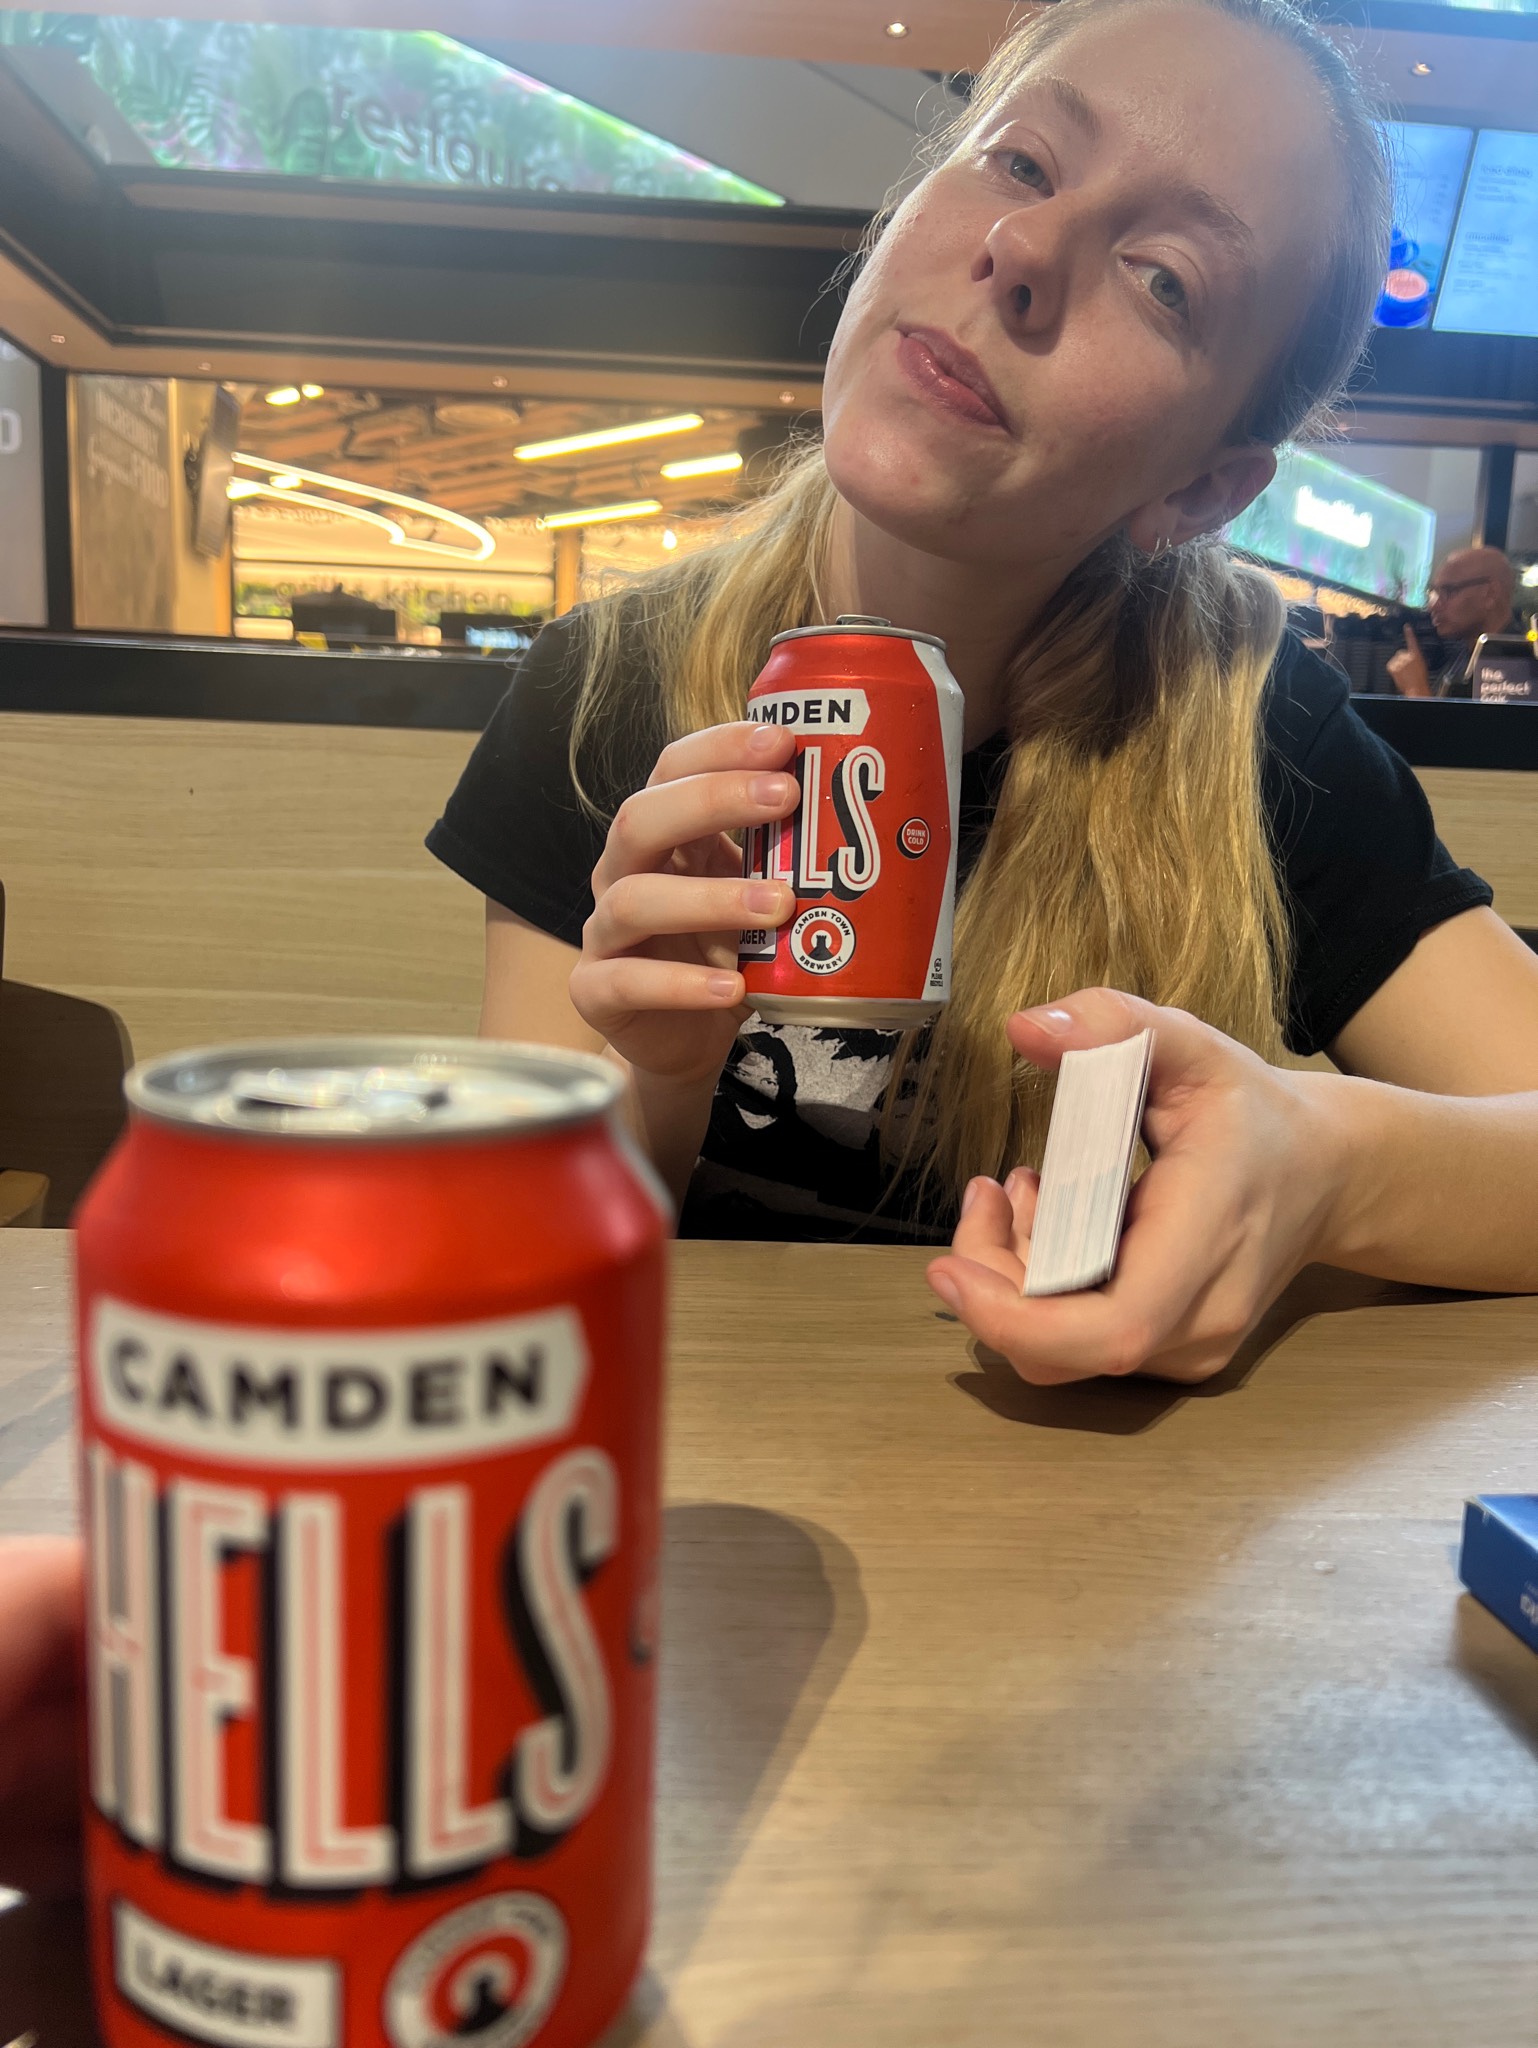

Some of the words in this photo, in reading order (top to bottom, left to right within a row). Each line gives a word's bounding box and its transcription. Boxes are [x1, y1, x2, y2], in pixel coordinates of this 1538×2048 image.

[1481, 667, 1504, 681] the
[1480, 680, 1530, 695] perfect
[747, 699, 851, 725] AMDEN
[906, 828, 926, 837] DRINK
[907, 836, 924, 845] COLD
[794, 910, 828, 936] CAMDEN
[830, 912, 851, 936] TOWN
[799, 955, 844, 971] BREWERY
[106, 1332, 546, 1436] CAMDEN
[88, 1443, 622, 1898] HELLS
